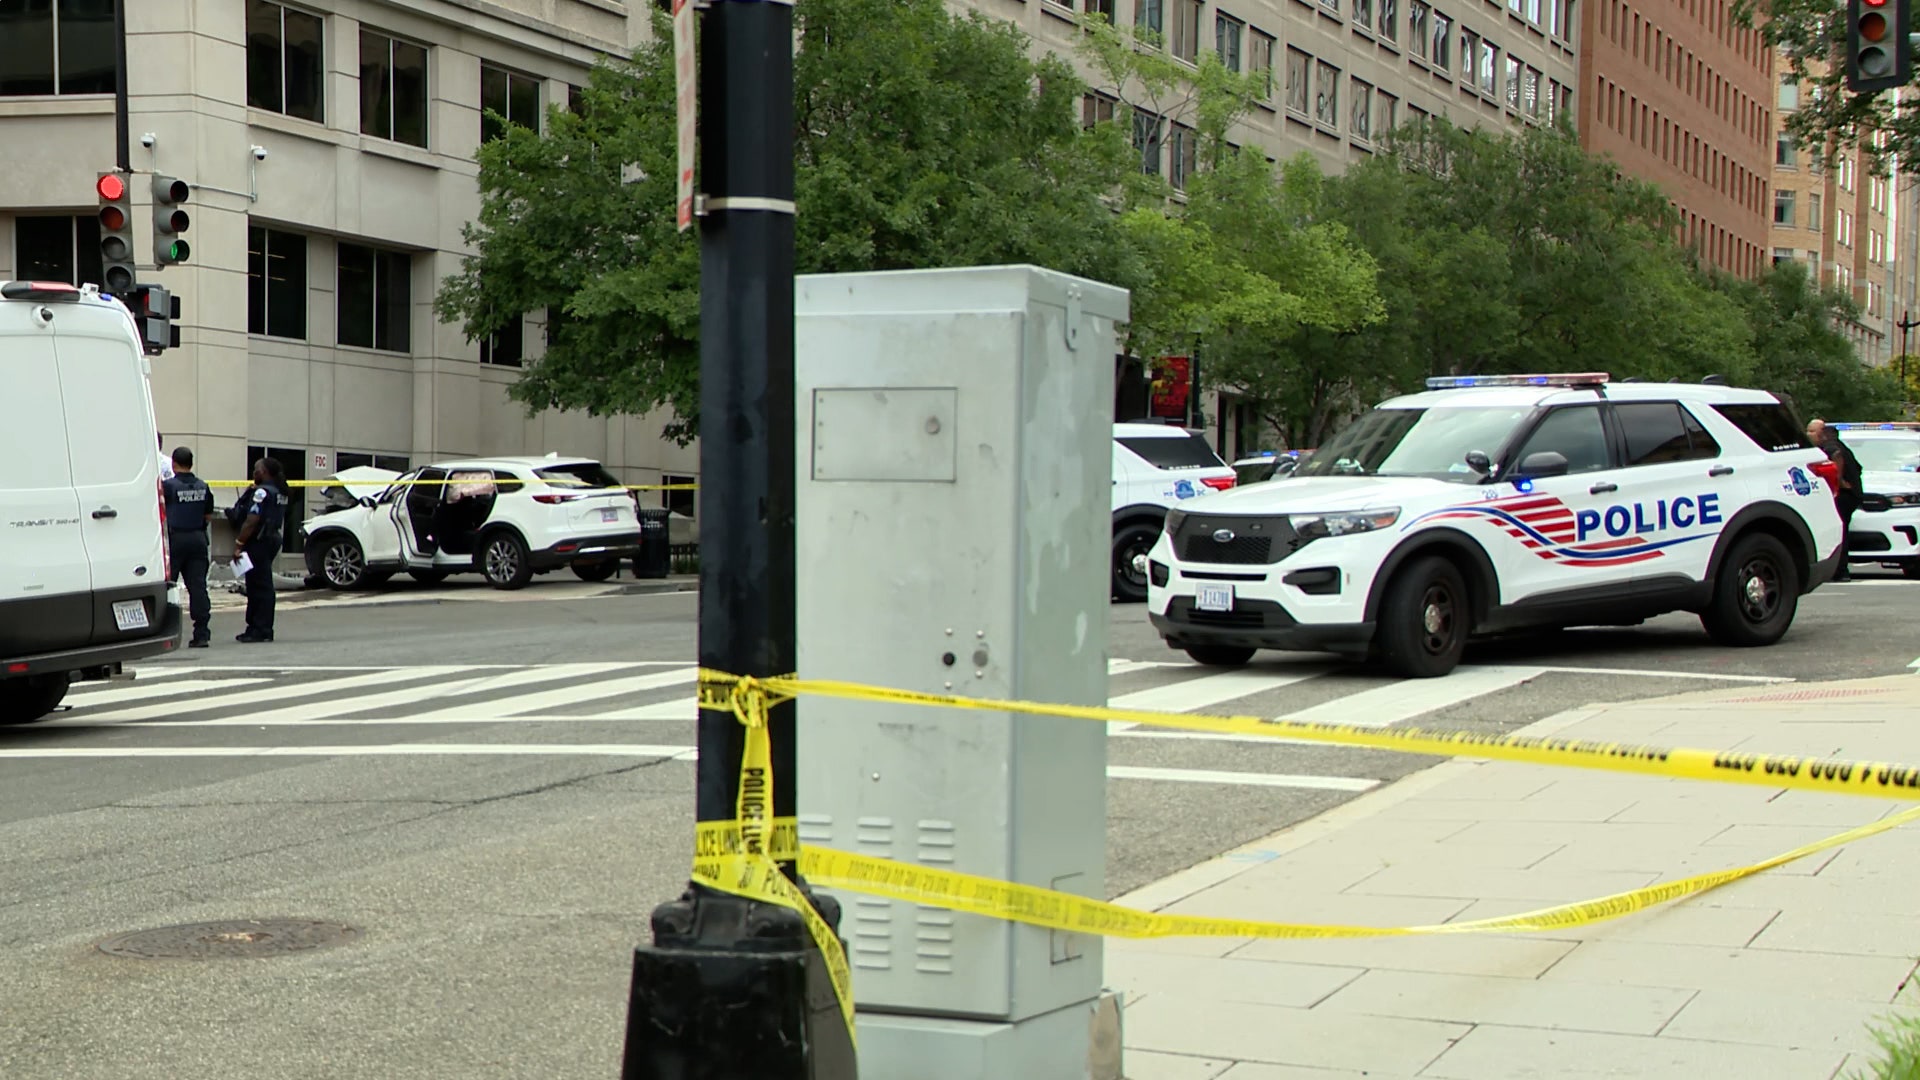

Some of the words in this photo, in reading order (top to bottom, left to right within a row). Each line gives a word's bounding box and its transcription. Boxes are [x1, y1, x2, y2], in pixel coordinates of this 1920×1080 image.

[315, 455, 327, 467] FDC
[178, 494, 206, 503] POLICE
[1576, 493, 1722, 542] POLICE
[741, 767, 765, 821] POLICE
